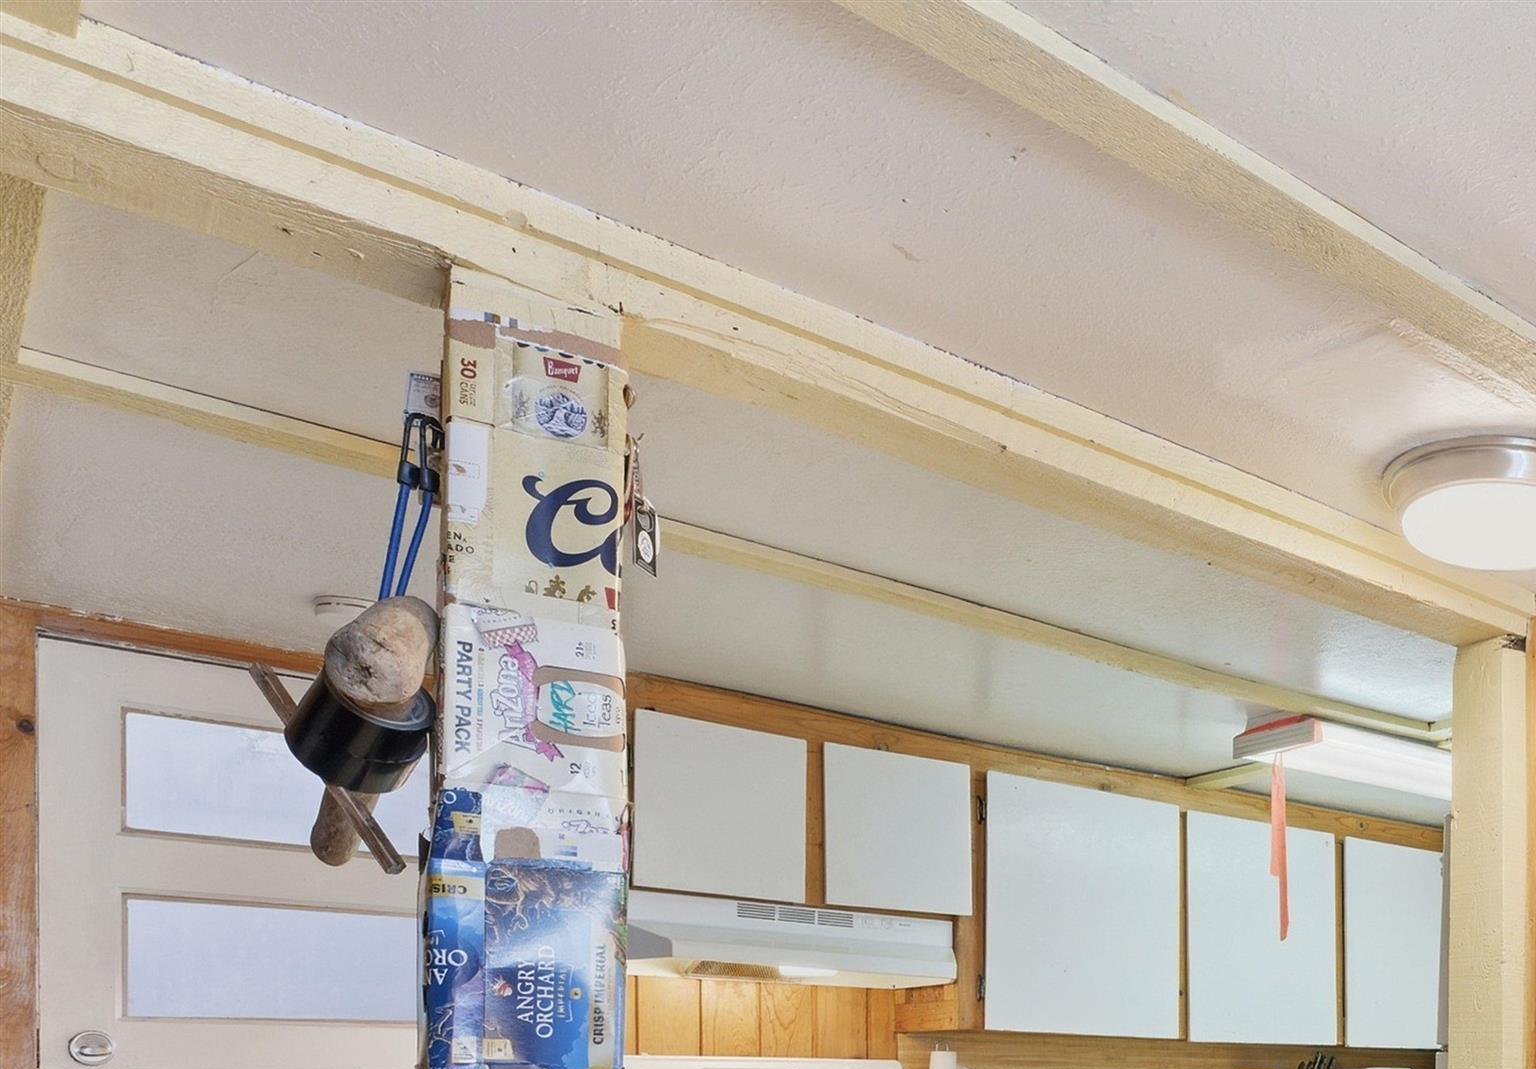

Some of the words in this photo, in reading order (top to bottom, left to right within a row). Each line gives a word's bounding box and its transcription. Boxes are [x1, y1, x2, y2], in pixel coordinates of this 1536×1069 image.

[461, 358, 477, 379] 30
[456, 640, 473, 700] PARTY
[455, 704, 471, 753] PACK
[598, 694, 612, 729] Teas
[570, 762, 582, 775] 12
[516, 959, 536, 1024] ANGRY
[536, 944, 556, 1039] ORCHARD
[595, 943, 607, 1004] IMPERIAL
[593, 1006, 606, 1045] CRISP
